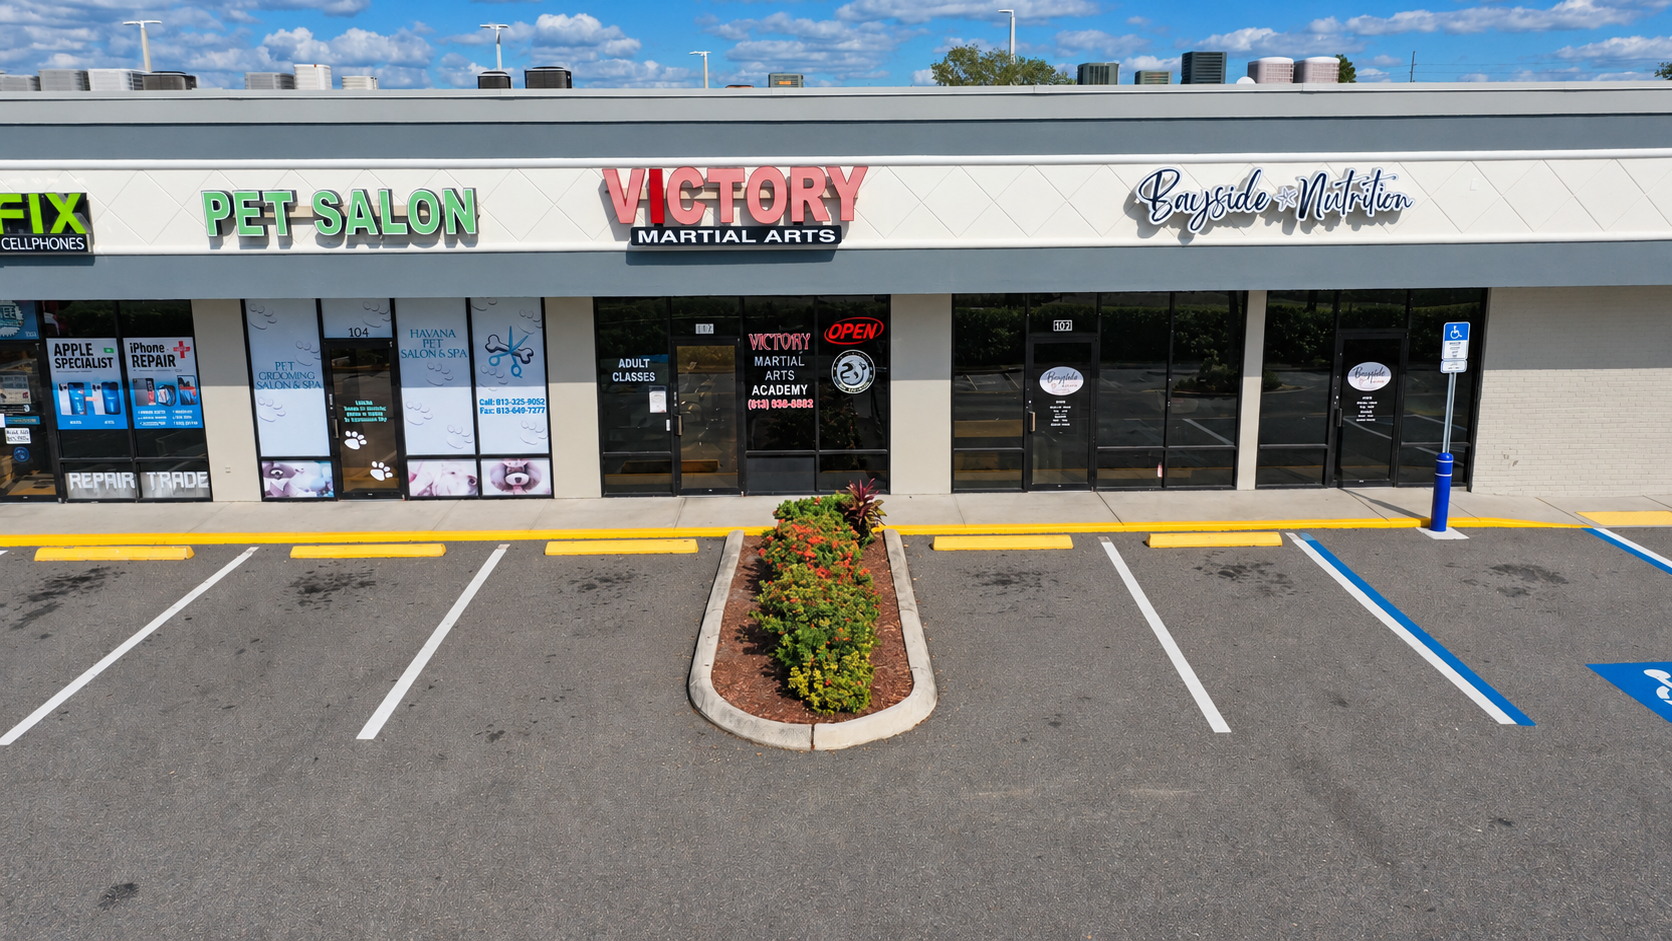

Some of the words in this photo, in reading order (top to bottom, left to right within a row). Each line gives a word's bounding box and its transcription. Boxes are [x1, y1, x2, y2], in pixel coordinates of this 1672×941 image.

[602, 166, 868, 225] VICTORY
[1136, 167, 1271, 233] Bayside
[1296, 167, 1415, 220] Nutrition
[0, 193, 86, 234] FIX
[201, 190, 293, 237] PET
[312, 188, 477, 236] SALON
[638, 230, 757, 243] MARTIAL
[764, 229, 836, 242] ARTS
[1, 237, 85, 250] CELLPHONES
[348, 327, 369, 338] 104
[410, 329, 457, 338] HAVANA
[828, 323, 878, 339] OPEN
[129, 342, 165, 353] iPhone
[422, 339, 443, 348] PET
[748, 332, 811, 351] VICTORY
[54, 343, 94, 356] APPLE
[401, 349, 437, 359] SALON
[448, 348, 468, 358] SPA
[55, 357, 114, 369] SPECIALIST
[131, 354, 176, 368] REPAIR
[275, 361, 295, 371] PET
[618, 358, 651, 368] ADULT
[754, 355, 805, 367] MARTIAL
[612, 372, 656, 382] CLASSES
[765, 369, 795, 381] ARTS
[256, 381, 291, 390] SALON
[302, 380, 322, 389] SPA
[751, 384, 808, 396] ACADEMY
[68, 472, 136, 490] REPAIR
[146, 471, 209, 490] TRADE
